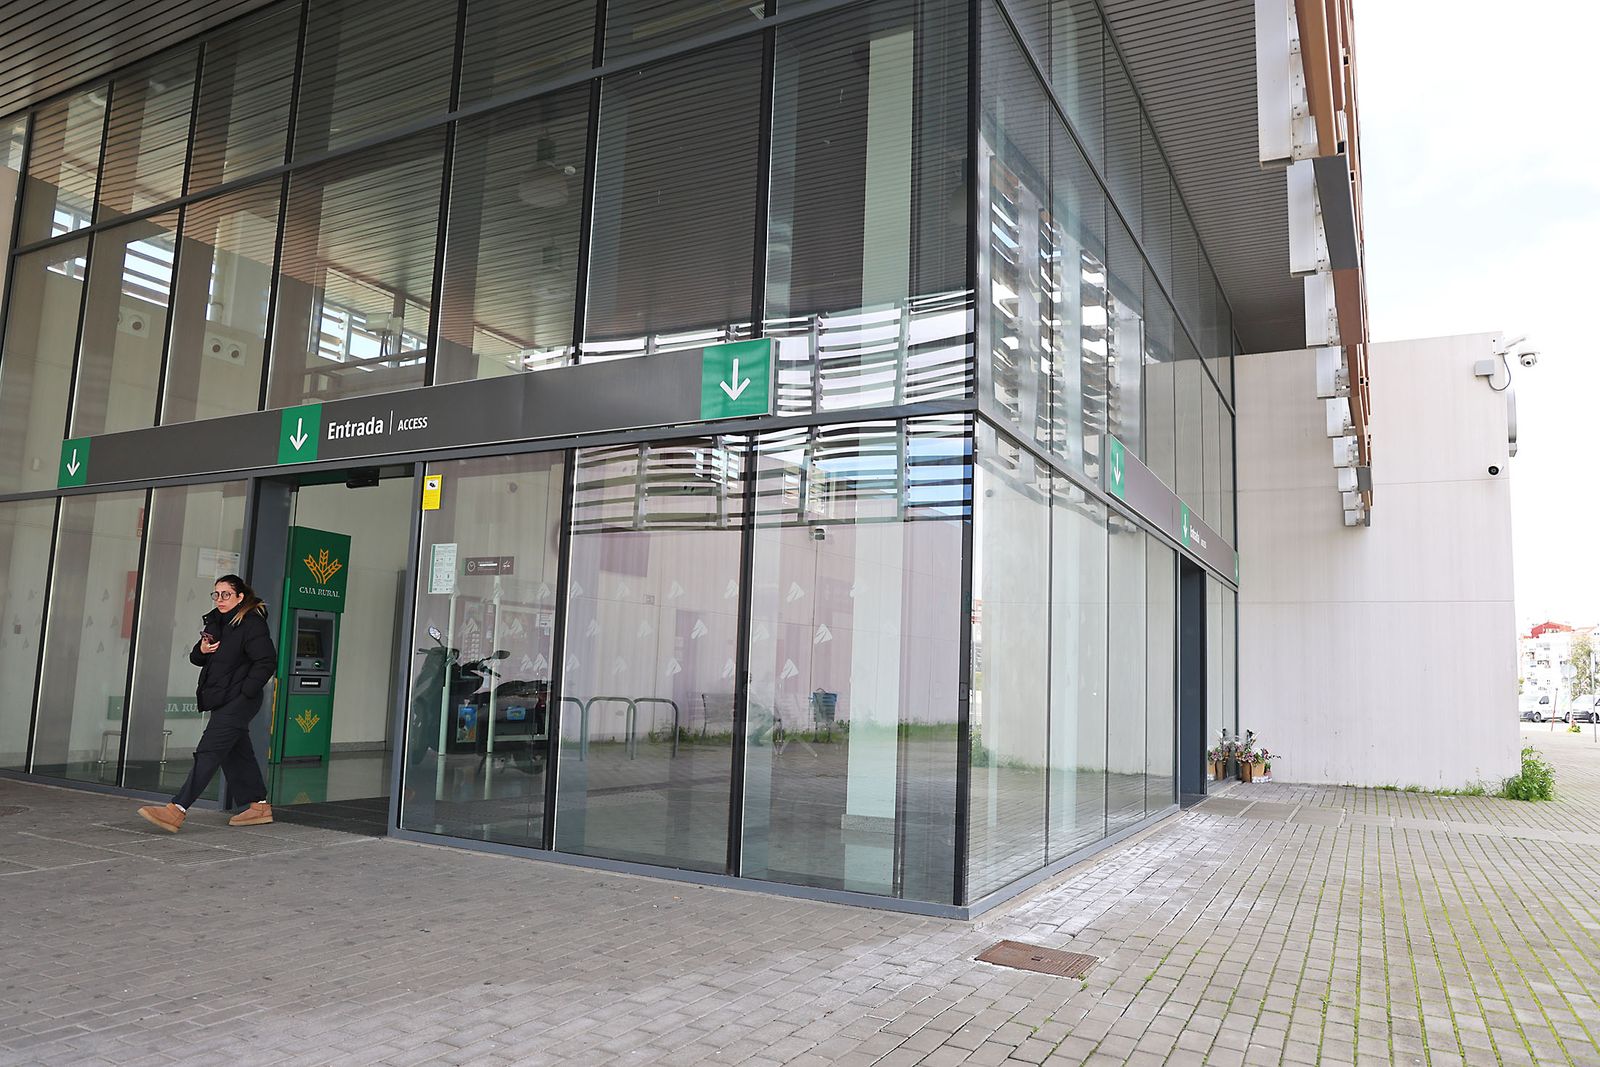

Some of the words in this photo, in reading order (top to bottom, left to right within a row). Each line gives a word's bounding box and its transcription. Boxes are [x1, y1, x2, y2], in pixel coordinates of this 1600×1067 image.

[327, 416, 384, 440] Entrada
[397, 416, 428, 431] ACCESS
[317, 588, 340, 597] RURAL
[164, 703, 180, 713] JA
[181, 703, 199, 713] RU
